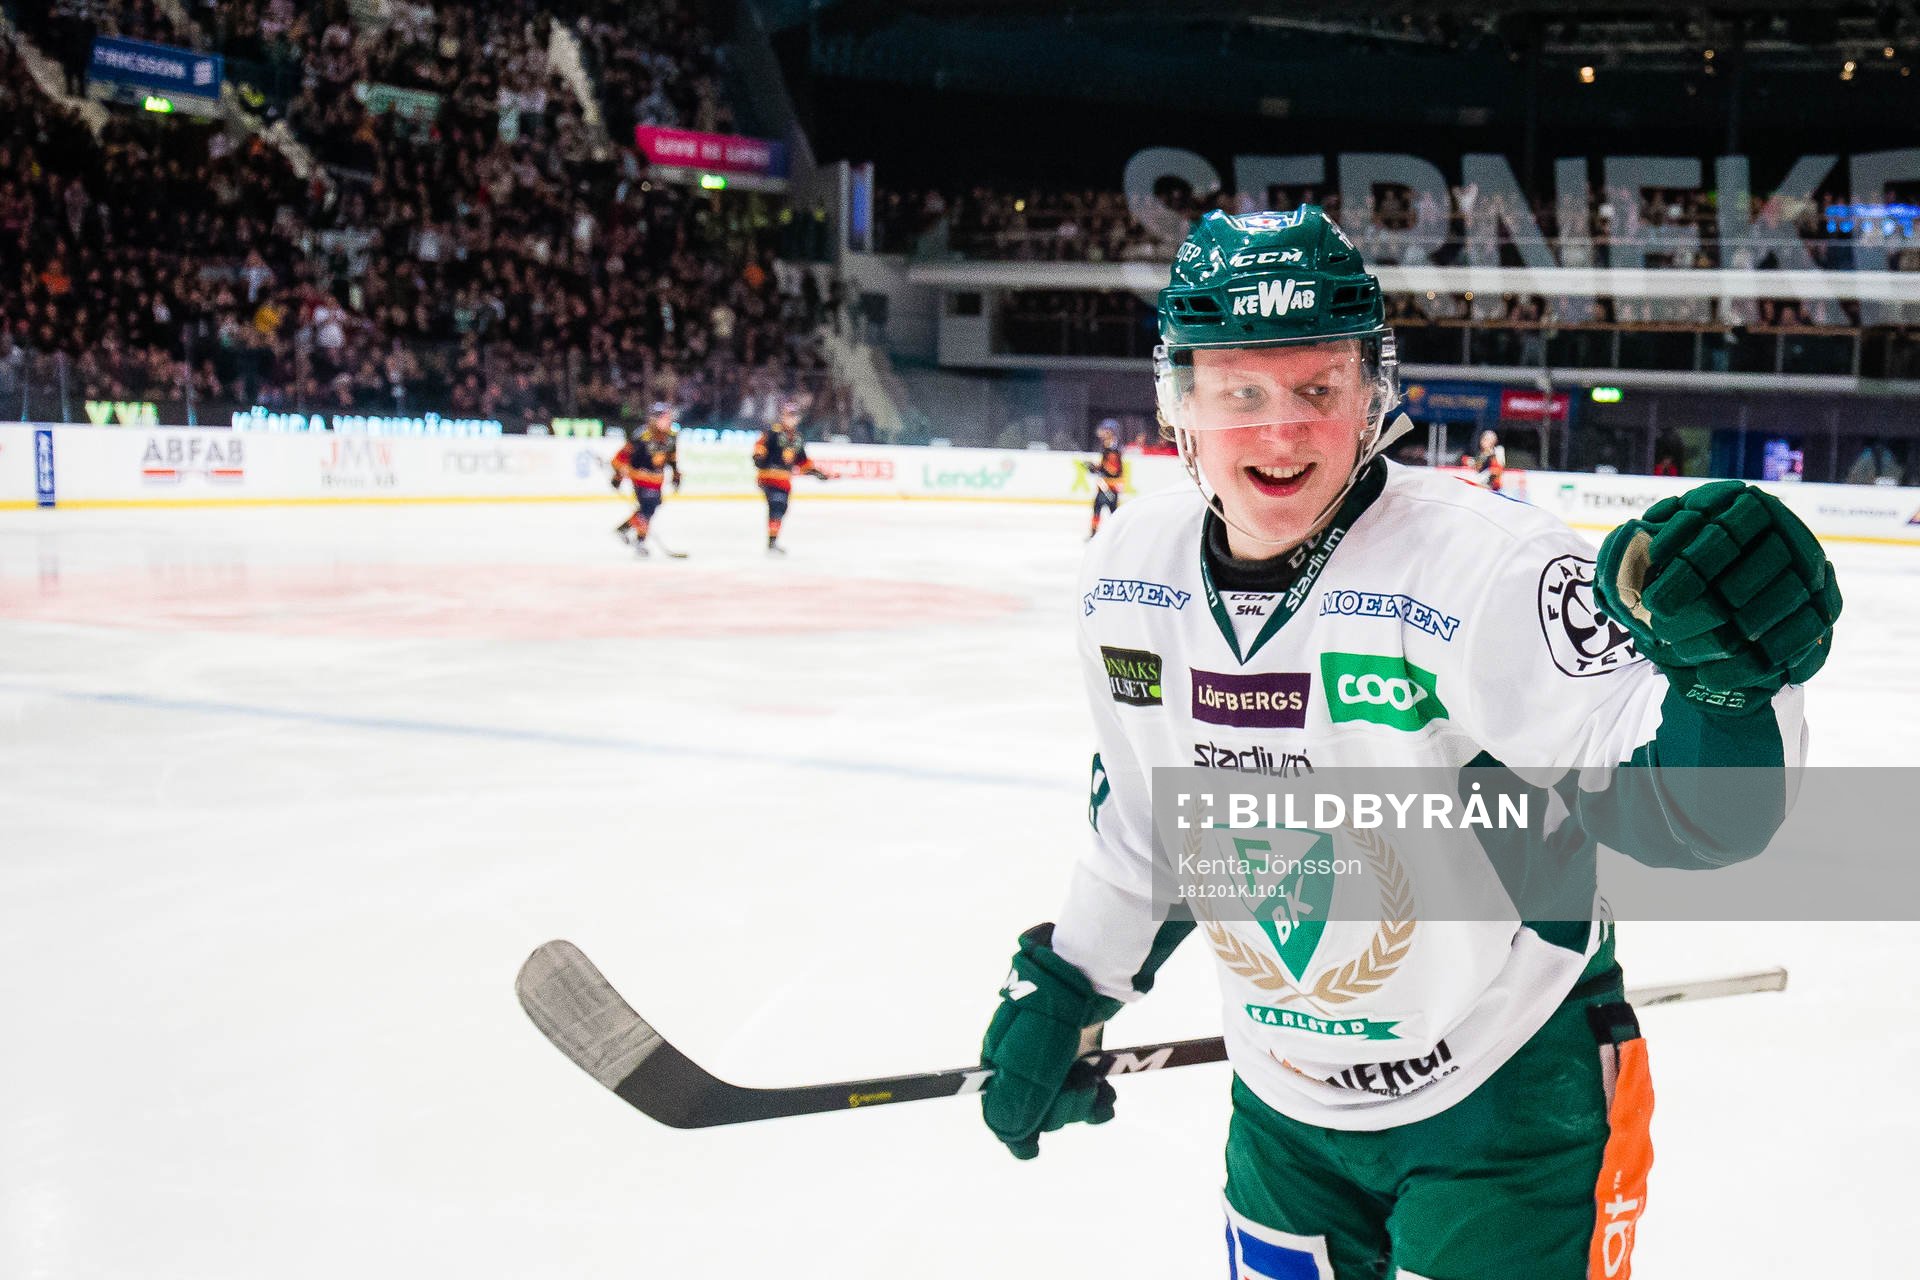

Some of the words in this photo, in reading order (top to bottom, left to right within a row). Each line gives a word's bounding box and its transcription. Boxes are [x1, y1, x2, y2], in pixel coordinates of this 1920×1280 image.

[1229, 248, 1304, 267] CCM
[1232, 279, 1316, 318] KEWAB
[142, 438, 244, 463] ABFAB
[1285, 527, 1346, 612] stadium
[1084, 579, 1191, 616] MELVEN
[1235, 605, 1265, 616] SHL
[1198, 684, 1303, 712] LÖFBERGS
[1194, 741, 1315, 778] stadium
[1250, 1006, 1366, 1035] KARLSTAD
